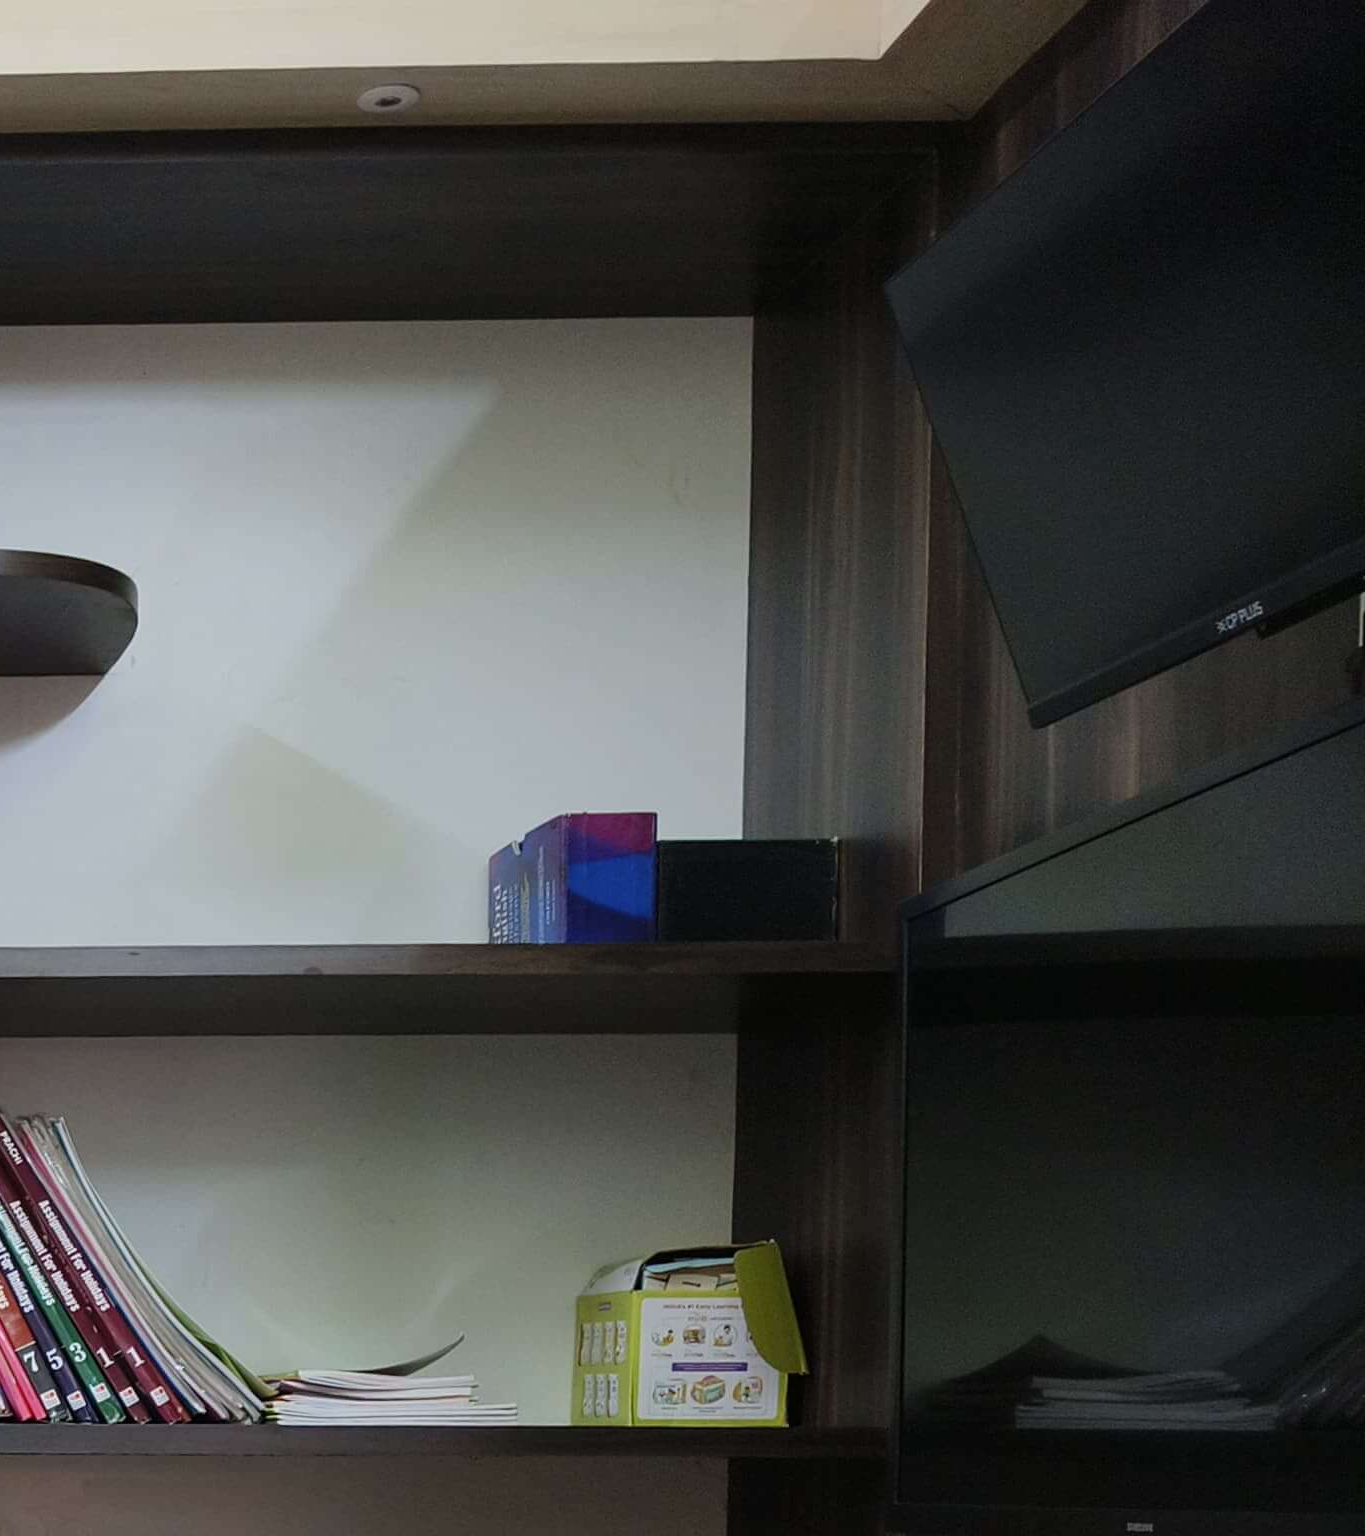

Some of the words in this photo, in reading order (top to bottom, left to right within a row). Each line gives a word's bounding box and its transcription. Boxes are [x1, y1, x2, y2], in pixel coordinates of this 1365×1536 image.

[0, 1130, 24, 1165] PRACHI
[38, 1199, 78, 1257] Assignment
[70, 1251, 87, 1272] For
[81, 1270, 111, 1312] Holidays
[126, 1346, 146, 1368] 1
[9, 1200, 47, 1258] Assignment
[41, 1252, 57, 1273] For
[51, 1270, 81, 1312] Holidays
[96, 1347, 115, 1368] 1
[7, 1269, 34, 1313] Holidays
[46, 1348, 64, 1371] 5
[23, 1350, 39, 1372] 7
[69, 1342, 87, 1363] 3
